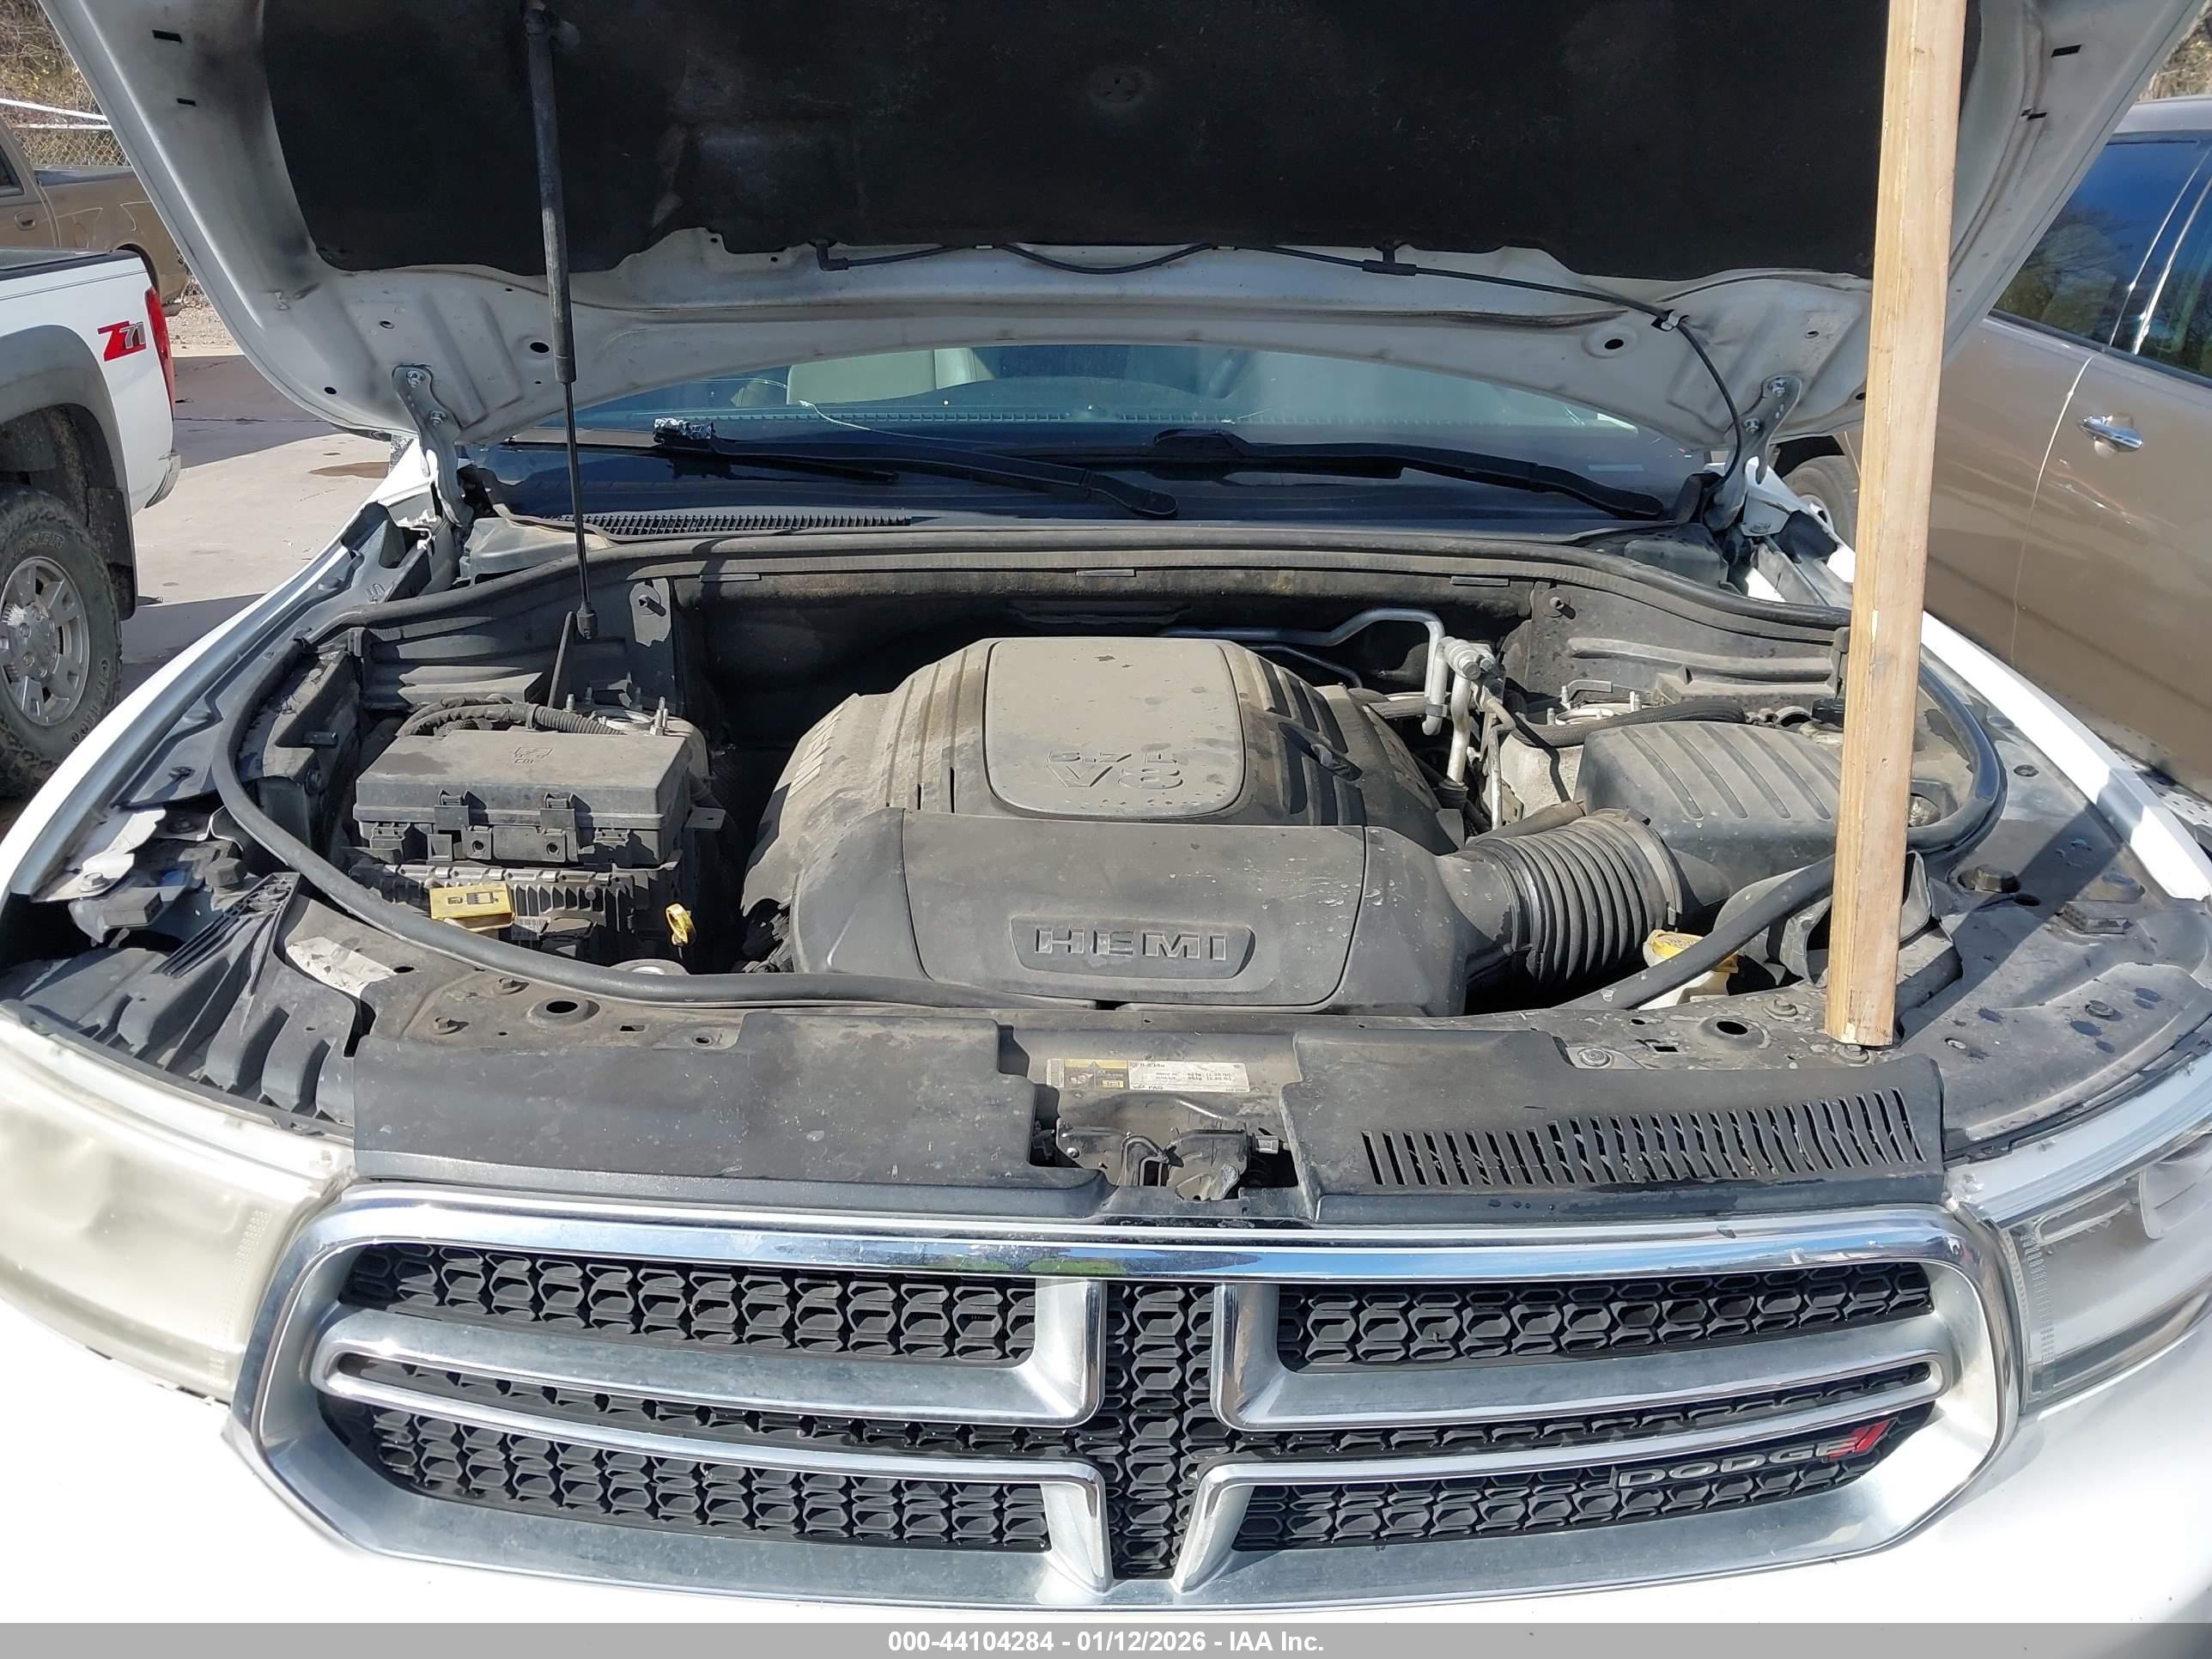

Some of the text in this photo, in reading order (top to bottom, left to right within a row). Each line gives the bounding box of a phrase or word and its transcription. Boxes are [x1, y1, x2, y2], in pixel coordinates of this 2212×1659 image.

[97, 320, 147, 362] Z71
[1045, 764, 1184, 790] V8
[1034, 927, 1227, 961] HEMI
[1618, 1436, 1856, 1487] DODGE
